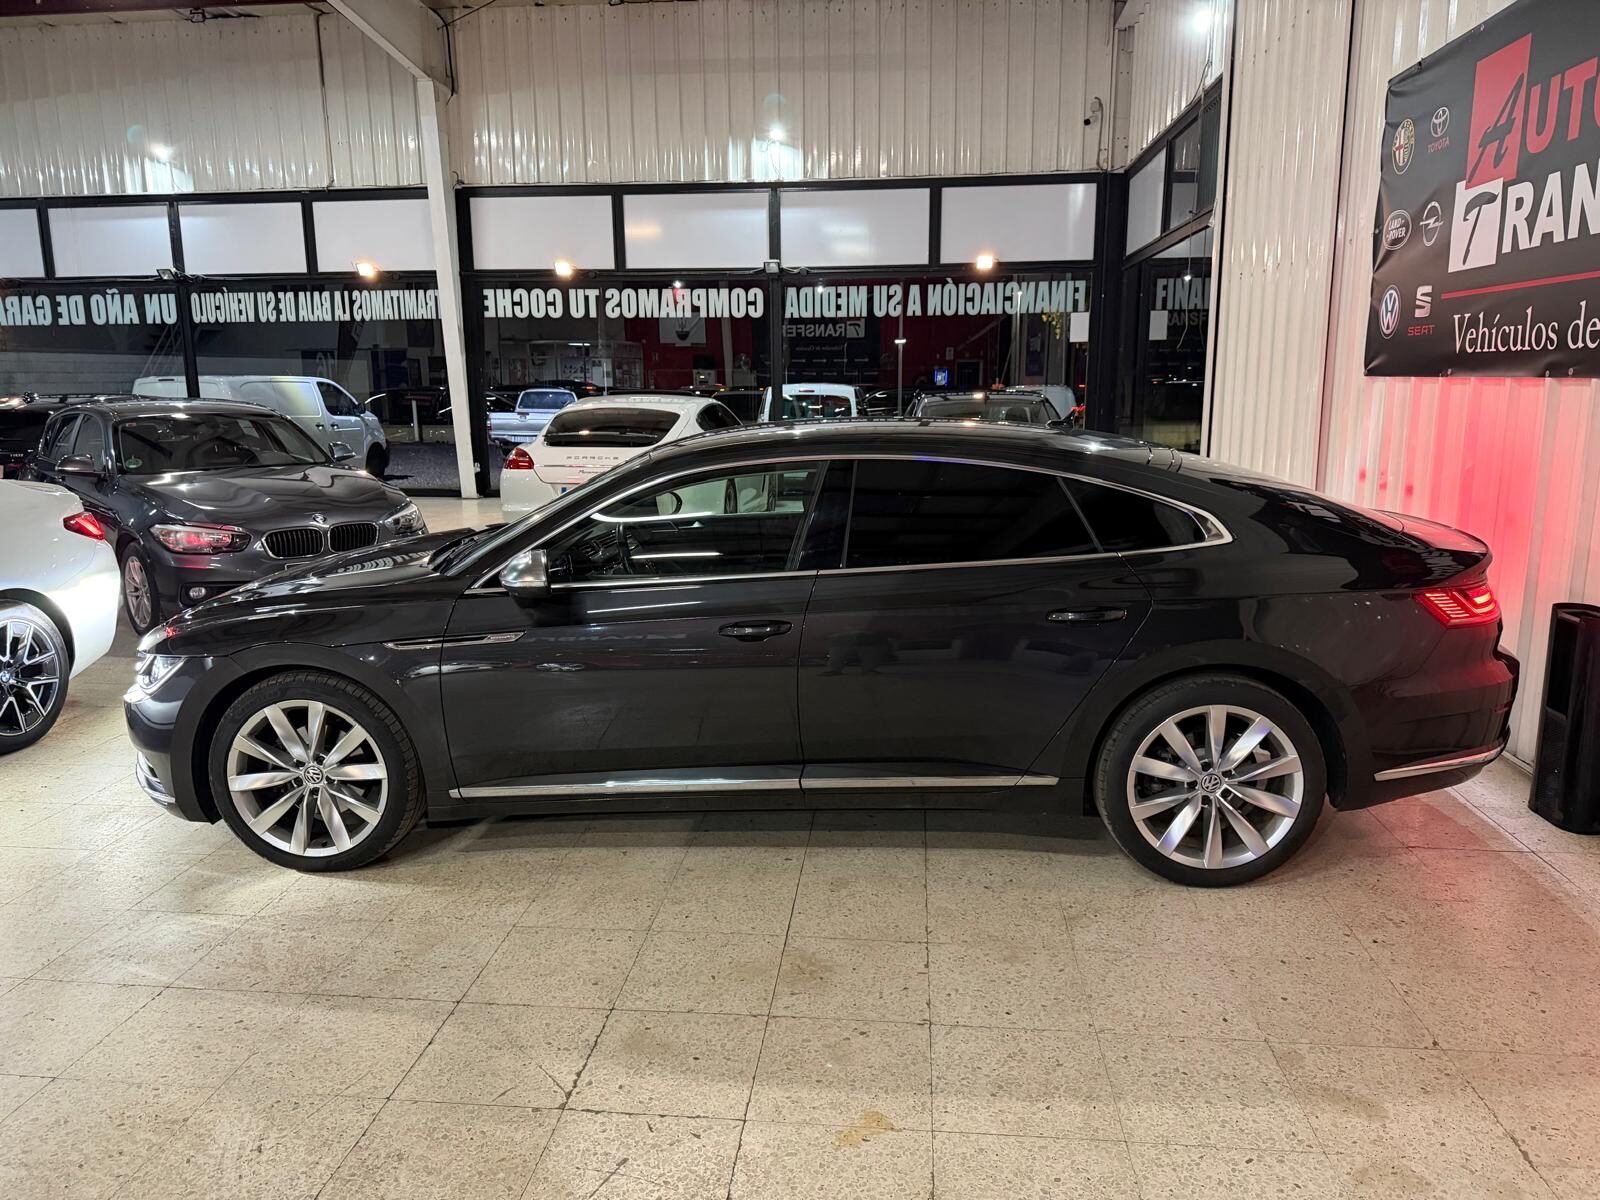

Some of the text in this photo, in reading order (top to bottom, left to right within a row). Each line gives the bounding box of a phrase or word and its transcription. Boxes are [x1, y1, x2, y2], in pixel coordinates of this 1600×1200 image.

[1466, 57, 1600, 183] AUT
[1427, 136, 1450, 152] TOYOTA
[1408, 324, 1436, 337] SEAT
[1454, 300, 1600, 353] Vehículos de
